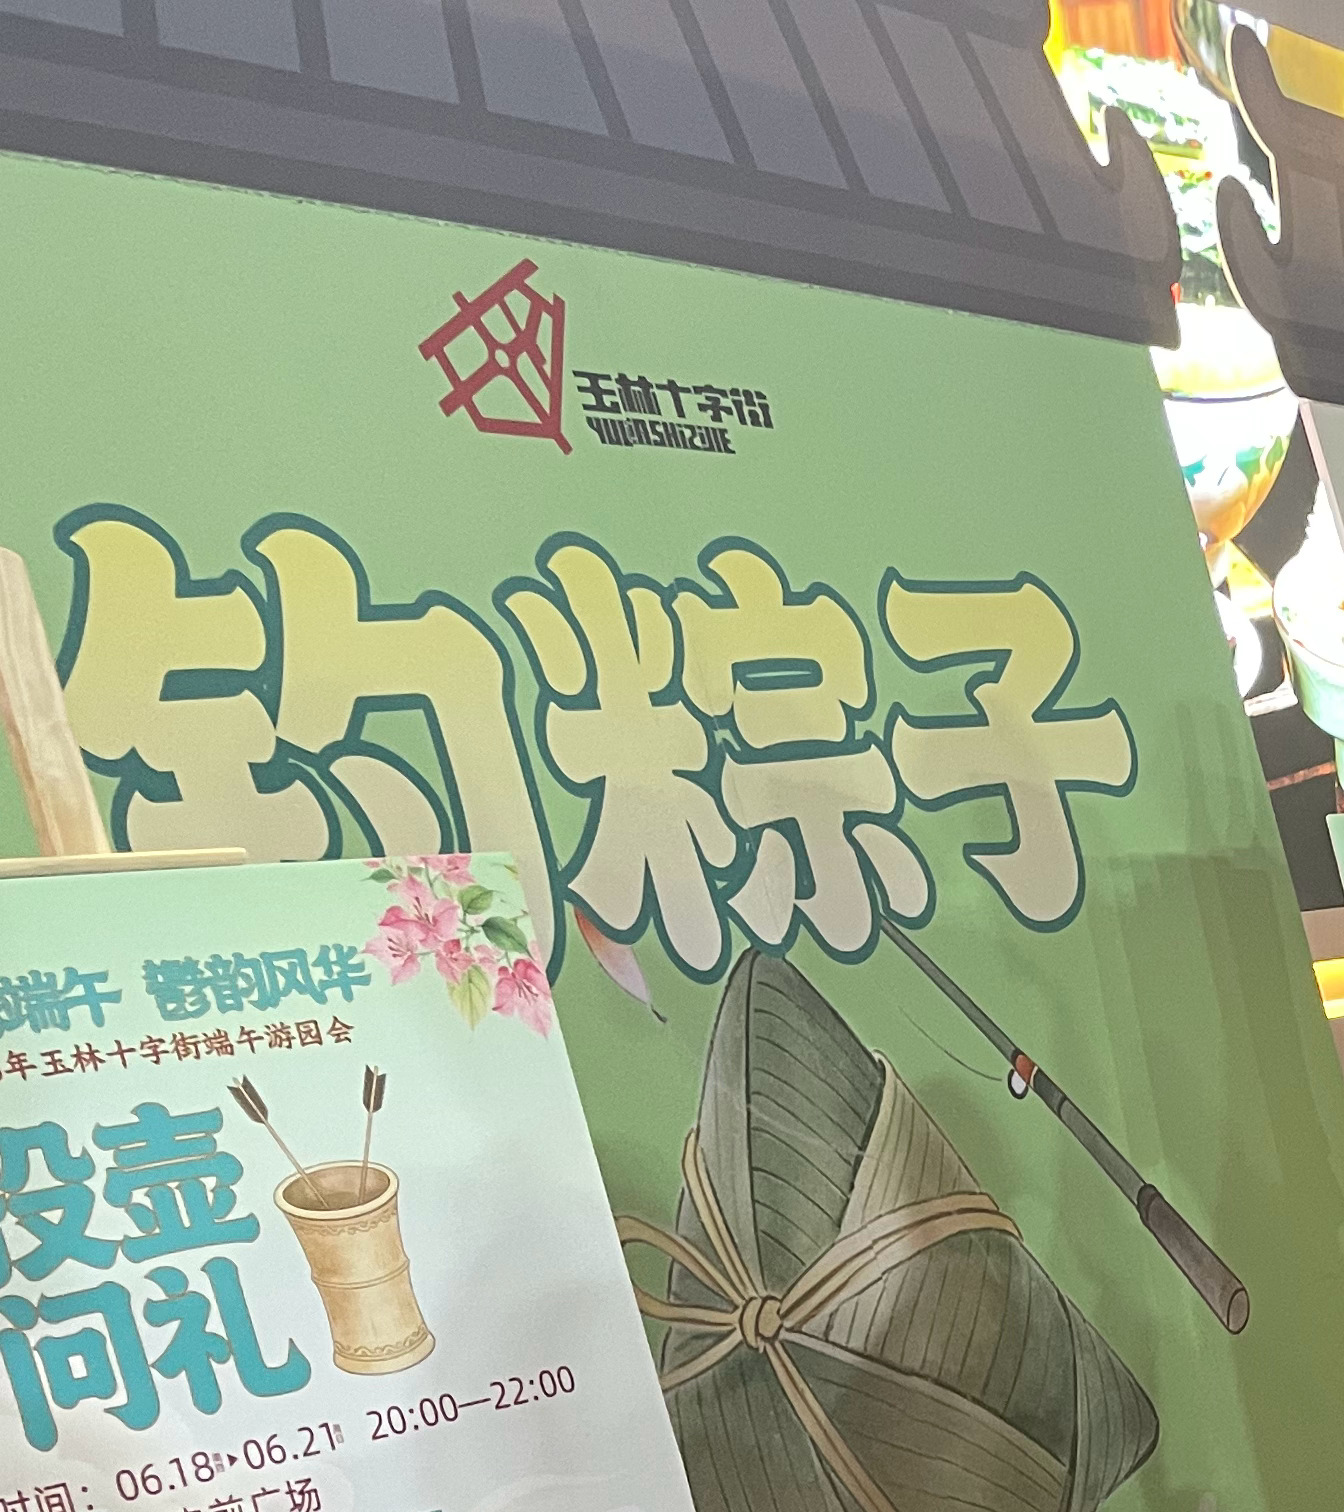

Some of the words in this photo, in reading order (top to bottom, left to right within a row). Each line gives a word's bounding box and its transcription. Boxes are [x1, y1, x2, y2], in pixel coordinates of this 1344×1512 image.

[572, 370, 774, 429] 玉林十字街
[53, 503, 1138, 983] 钓粽子
[0, 1015, 355, 1082] 年玉林十字街端午游园会
[0, 1257, 311, 1452] 问礼
